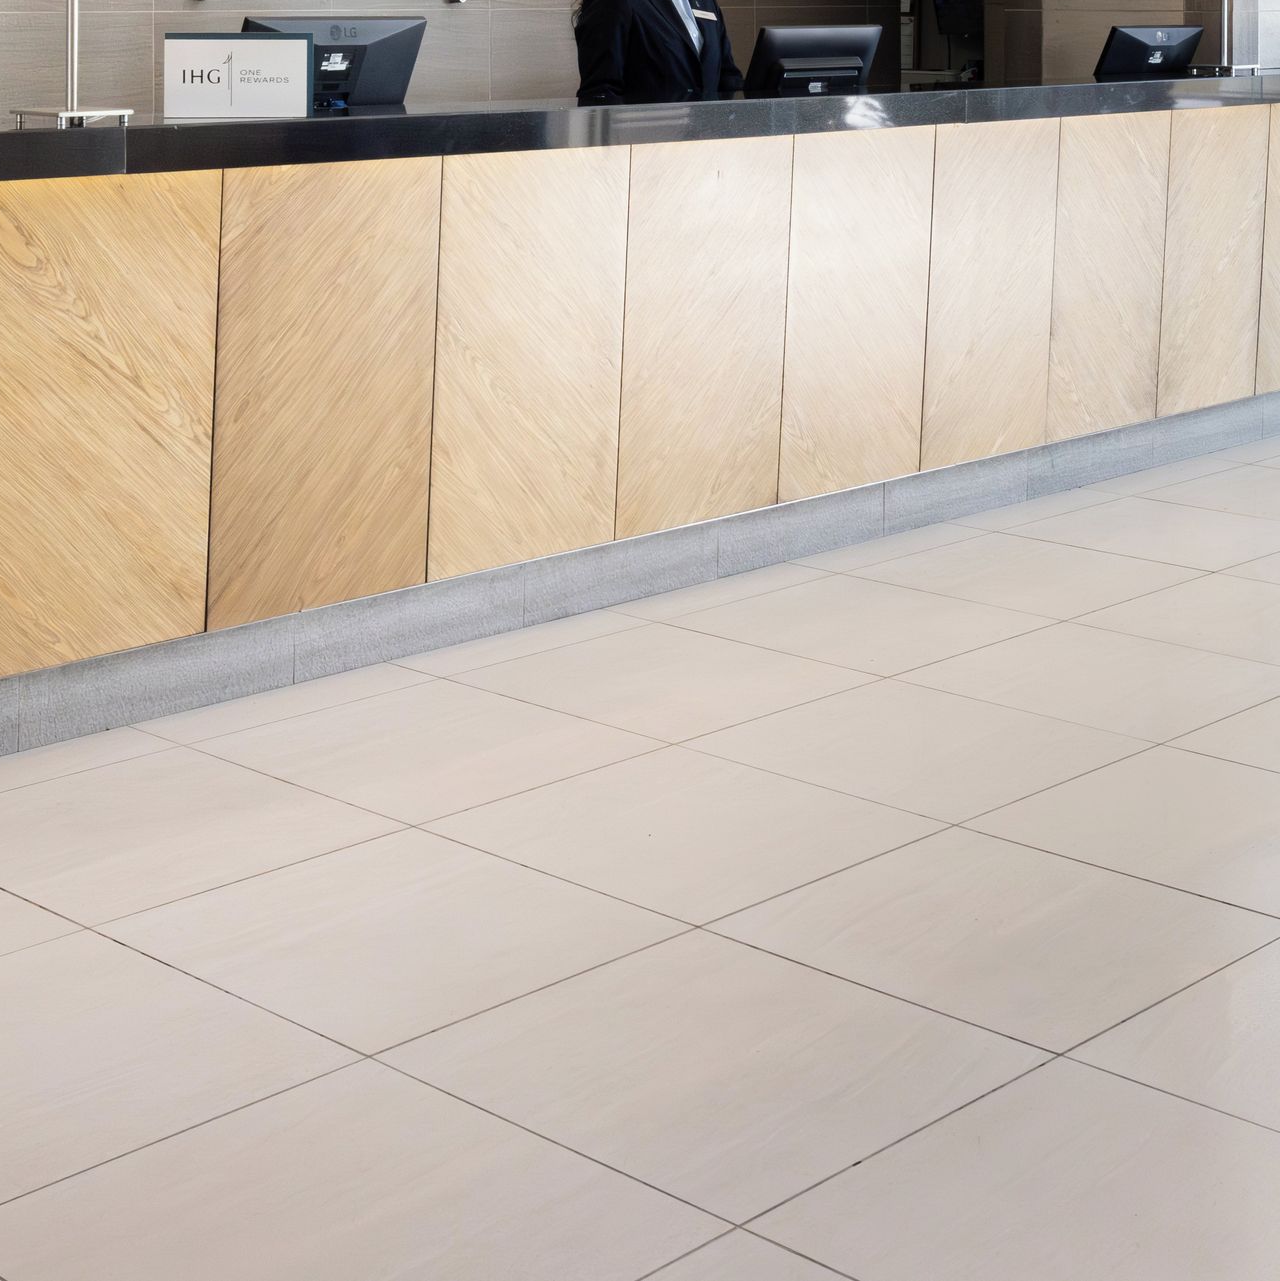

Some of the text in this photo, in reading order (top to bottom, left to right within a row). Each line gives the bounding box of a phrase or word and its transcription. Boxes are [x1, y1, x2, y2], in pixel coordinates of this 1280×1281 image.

[343, 27, 358, 39] LG
[182, 68, 221, 85] IHG
[239, 76, 290, 84] REWARDS
